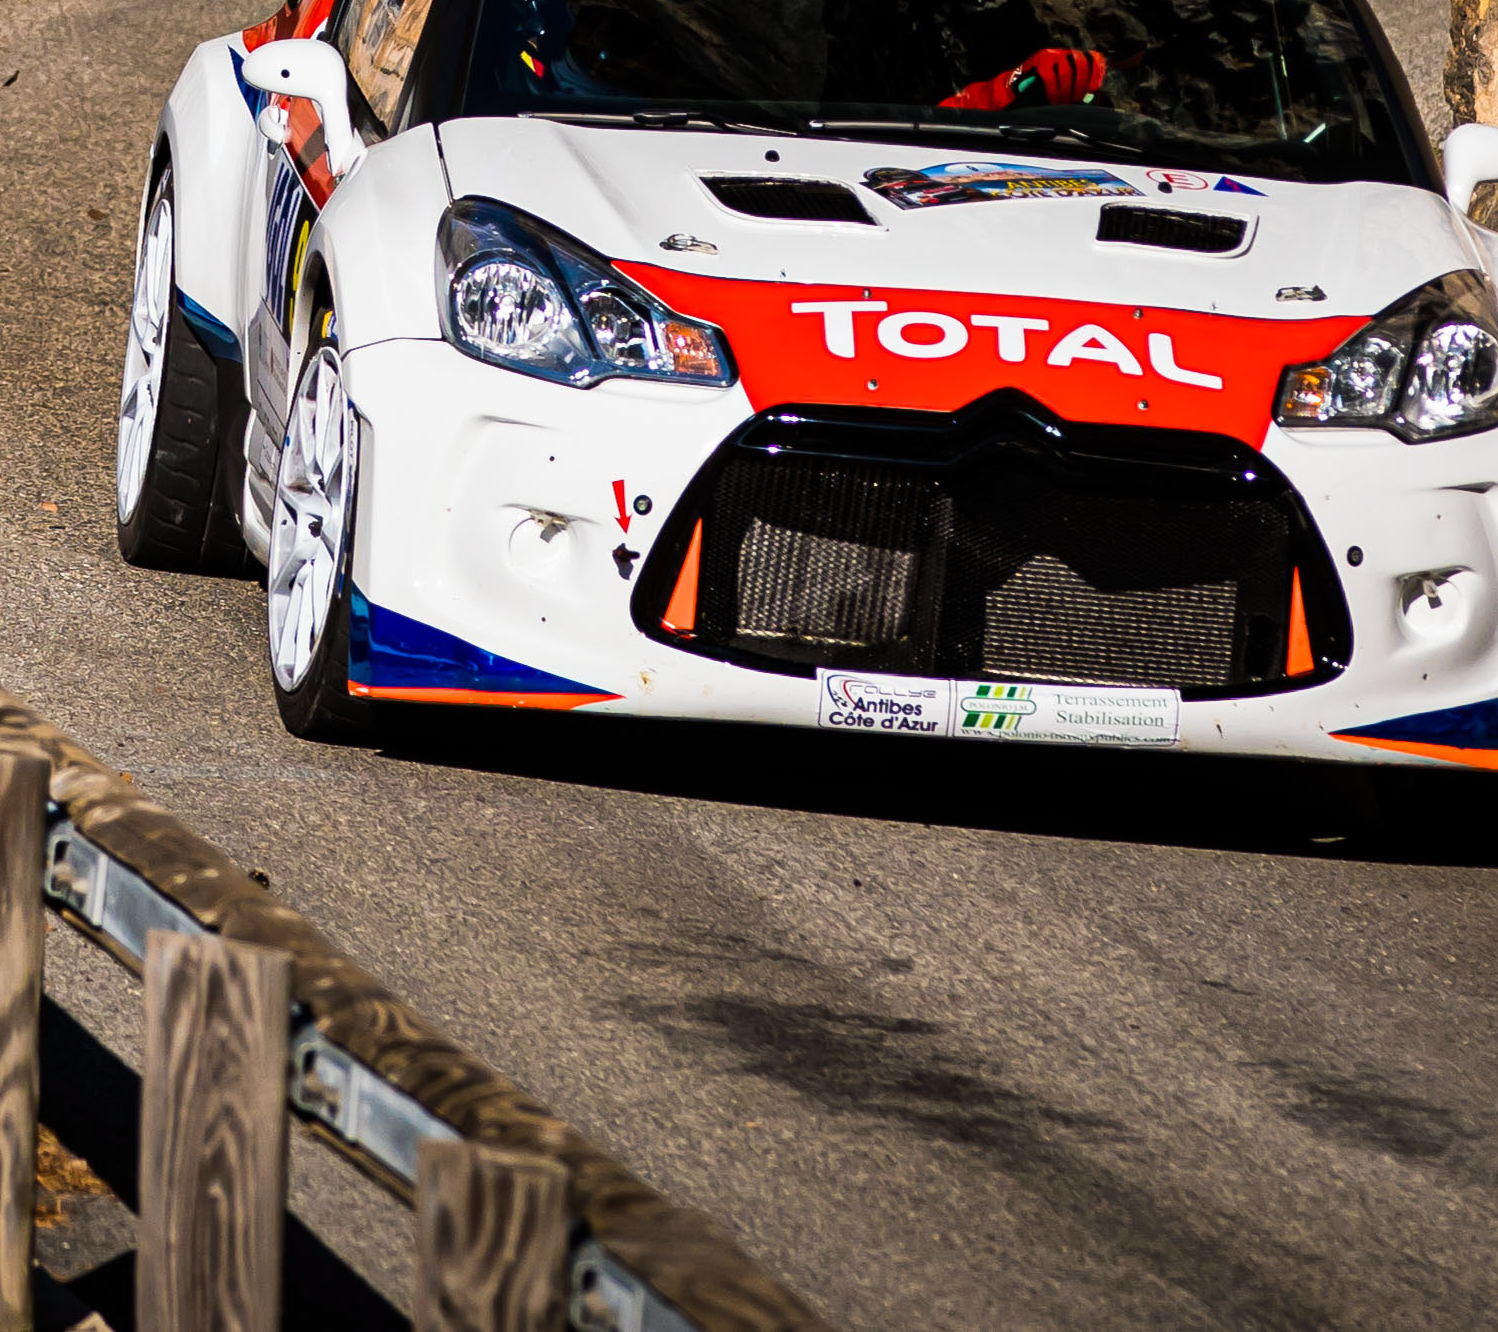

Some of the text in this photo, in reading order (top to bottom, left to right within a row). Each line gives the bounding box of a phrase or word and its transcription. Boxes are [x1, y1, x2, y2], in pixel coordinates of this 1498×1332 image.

[791, 300, 1223, 390] TOTAL
[853, 697, 922, 717] Antibes
[1054, 692, 1168, 709] Terrassement
[829, 711, 939, 733] Côte d'Azur
[1055, 710, 1165, 728] Stabilisation
